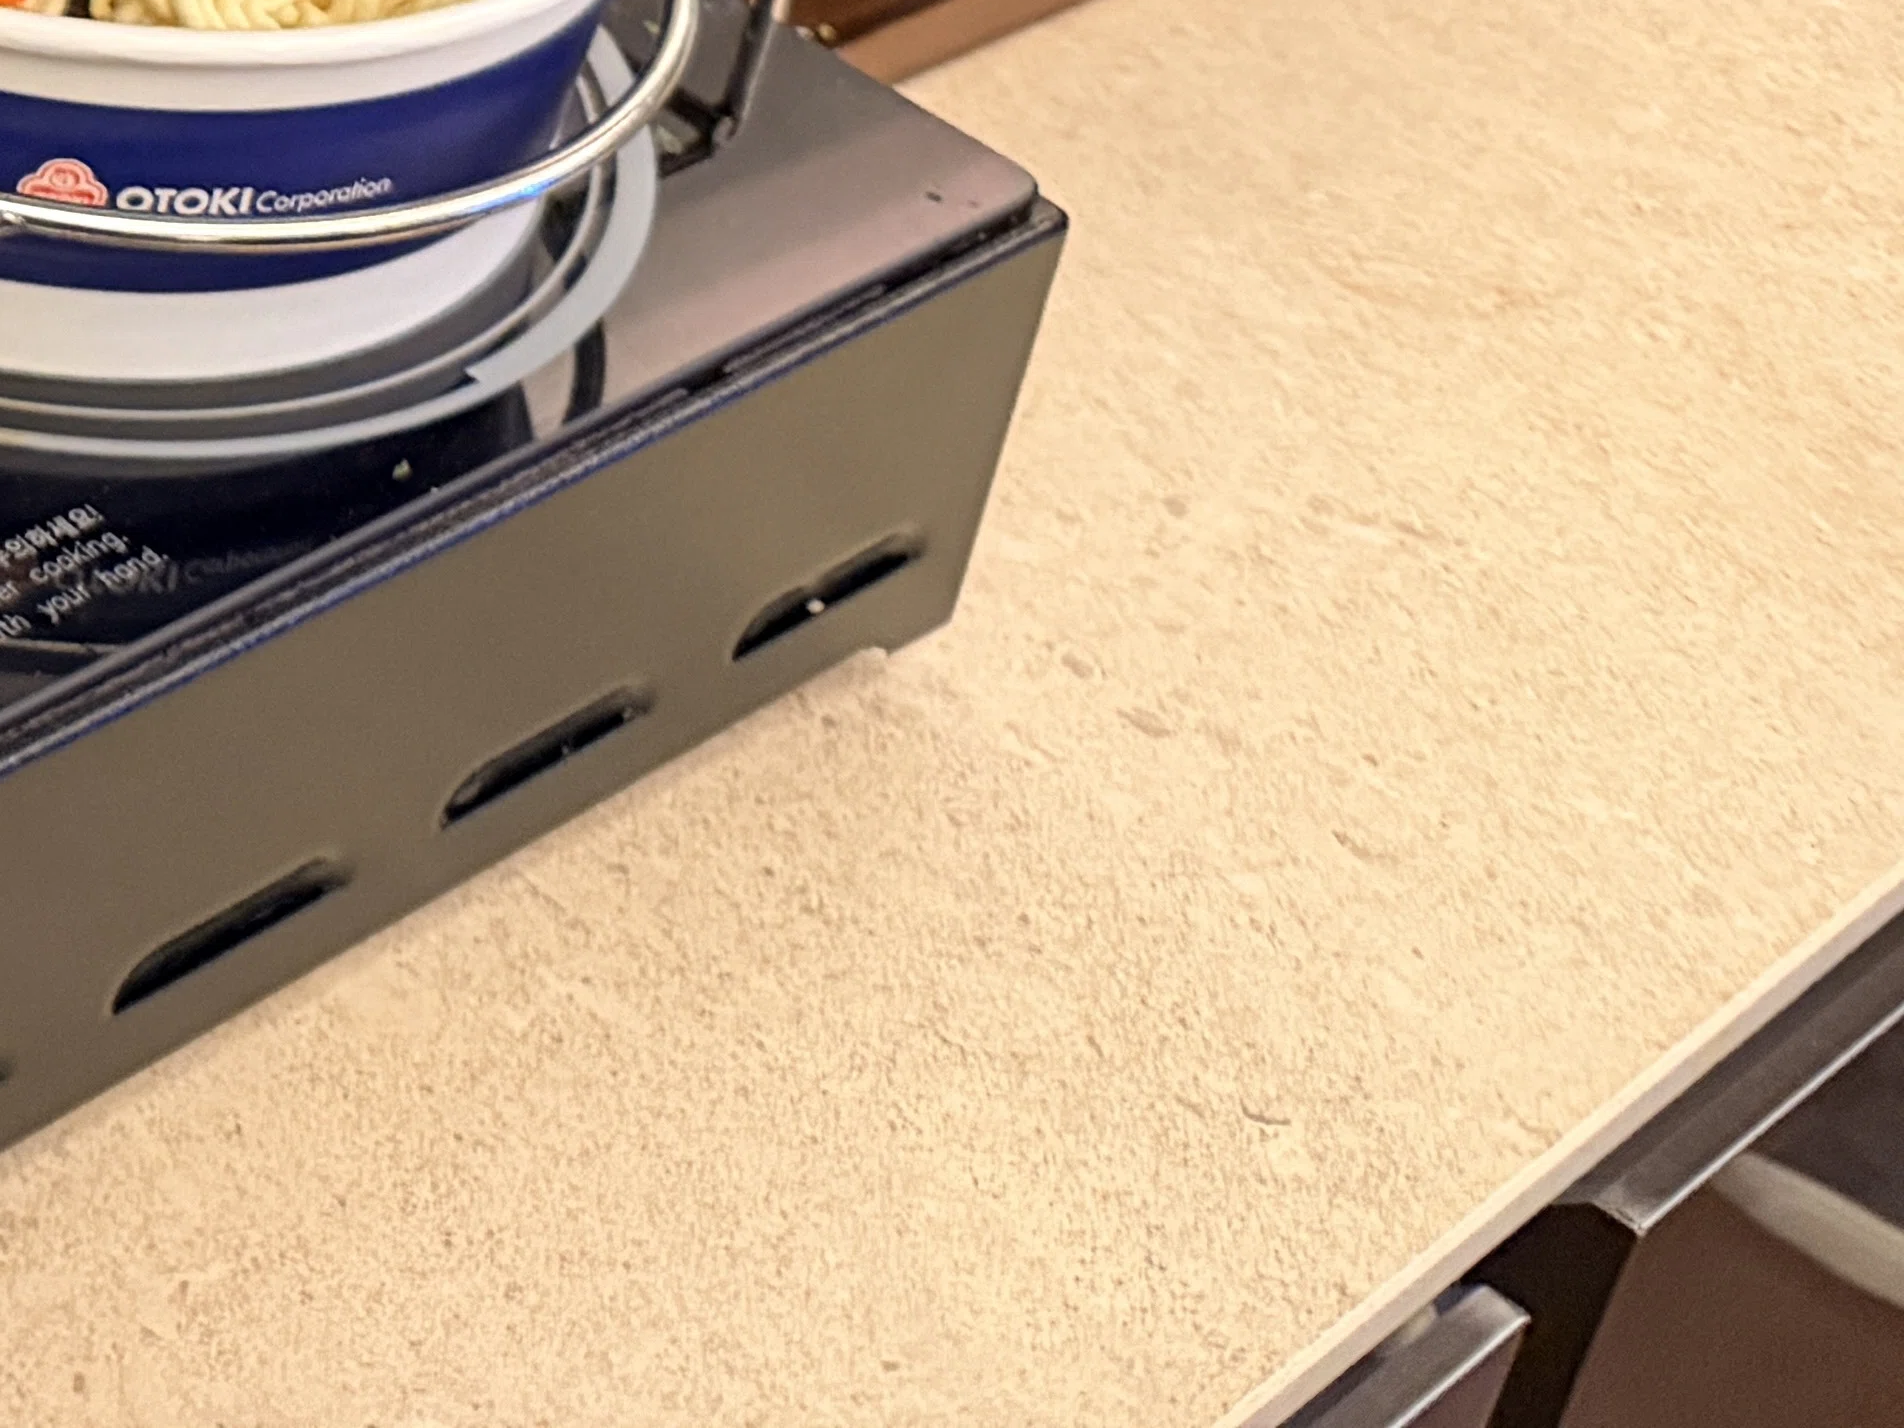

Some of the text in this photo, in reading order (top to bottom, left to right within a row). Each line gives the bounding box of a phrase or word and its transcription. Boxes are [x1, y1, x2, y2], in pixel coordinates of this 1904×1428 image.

[116, 167, 392, 215] OTOKI Corporation
[29, 531, 130, 587] cooking.
[37, 582, 92, 625] your
[93, 545, 170, 590] hand.
